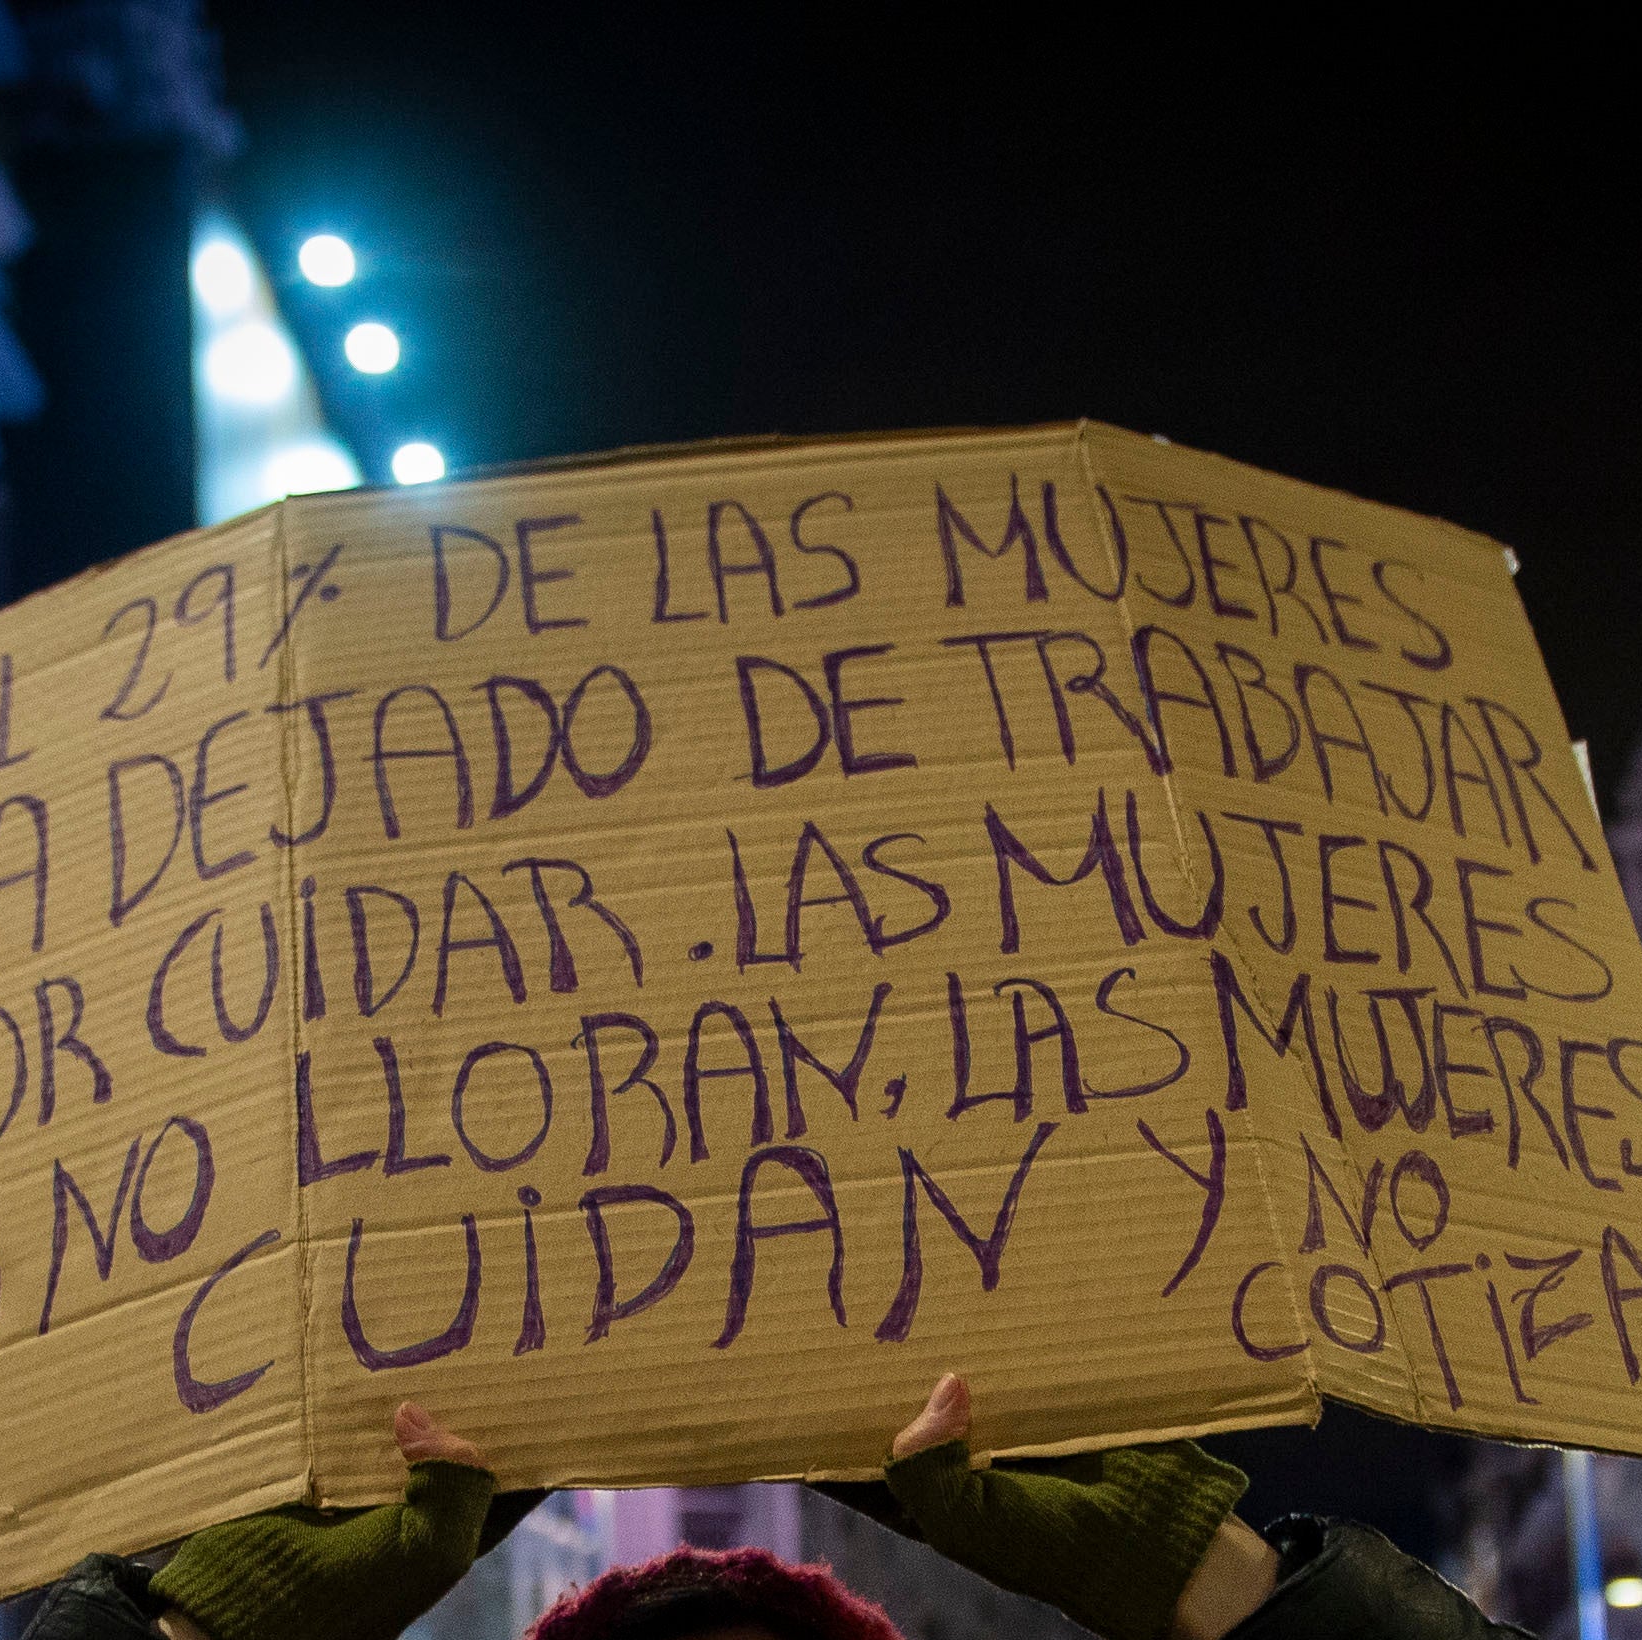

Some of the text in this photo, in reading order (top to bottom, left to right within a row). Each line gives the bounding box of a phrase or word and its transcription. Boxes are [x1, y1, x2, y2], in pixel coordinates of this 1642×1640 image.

[99, 540, 346, 722] 29%
[430, 516, 590, 643] DE
[649, 490, 861, 626] LAS
[934, 472, 1454, 672] MUJERES
[106, 662, 653, 926] DEJADO
[733, 642, 918, 790] DE
[942, 625, 1598, 872] TRABAJAR
[146, 856, 645, 1060] CUIDAR
[981, 785, 1614, 1002] MUJERES
[38, 1113, 215, 1338] NO
[292, 980, 908, 1190] LLORAN,
[945, 966, 1191, 1121] LAS
[171, 1108, 1227, 1415] CUIDAN Y
[1298, 1132, 1452, 1260] NO
